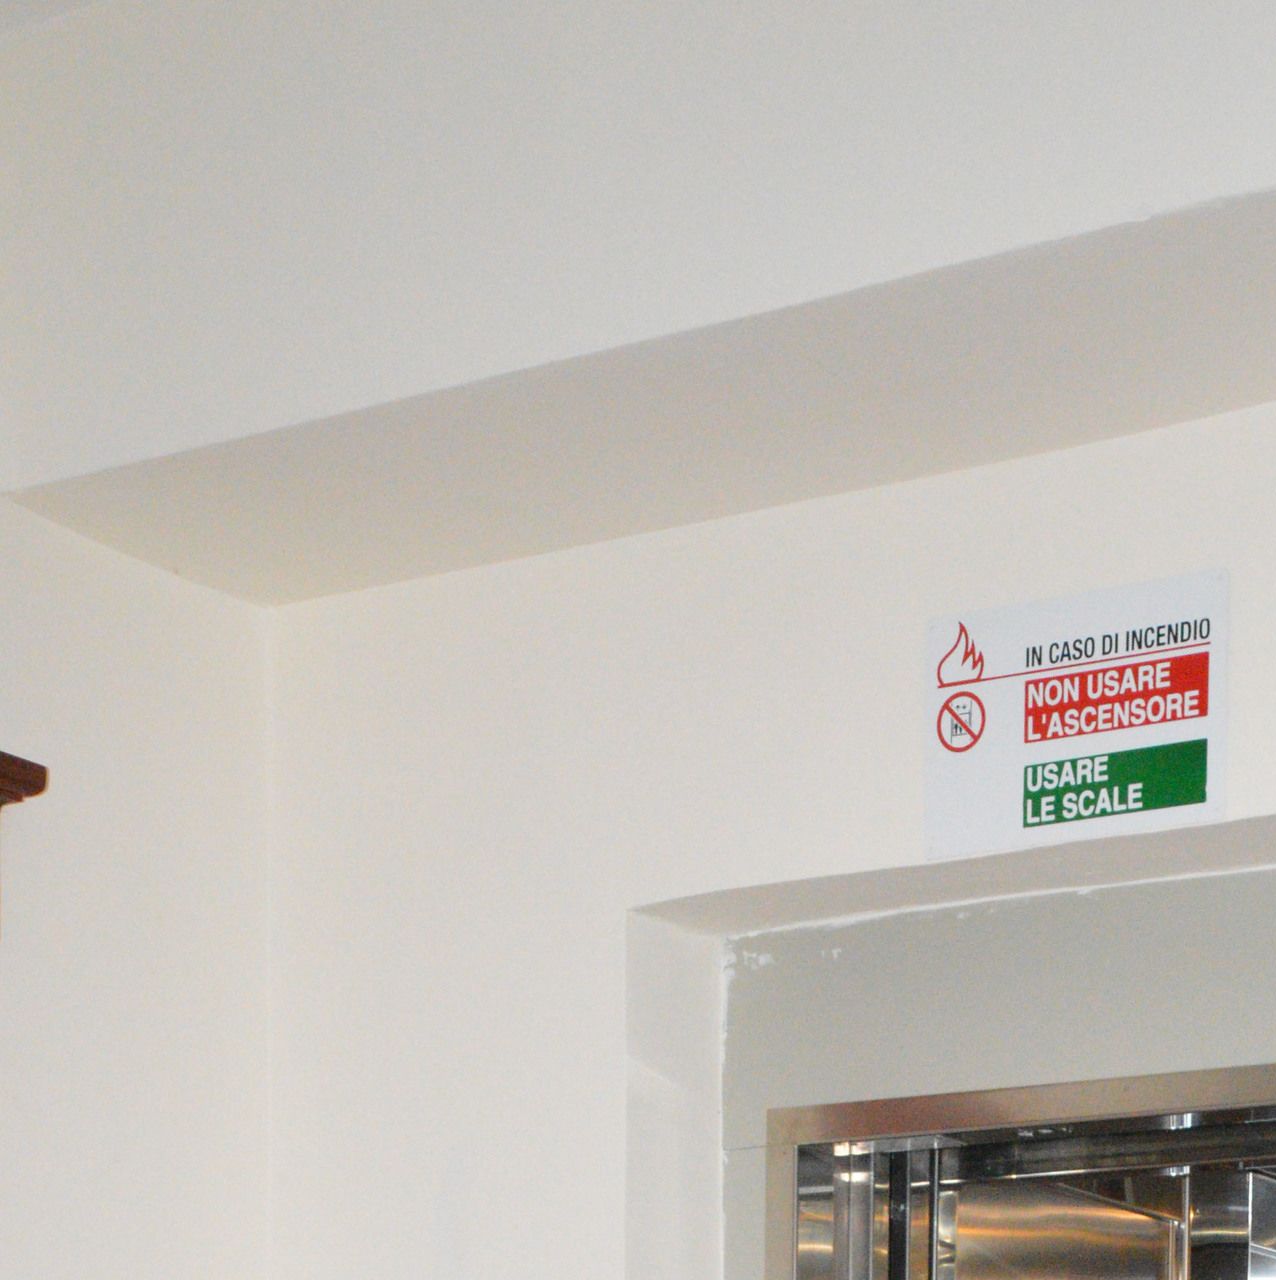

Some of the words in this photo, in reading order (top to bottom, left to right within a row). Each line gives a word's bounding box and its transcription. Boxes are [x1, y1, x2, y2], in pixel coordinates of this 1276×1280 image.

[1025, 645, 1042, 668] IN
[1049, 637, 1095, 664] CASO
[1102, 632, 1119, 655] DI
[1125, 618, 1211, 652] INCENDIO
[1027, 680, 1080, 709] NON
[1086, 662, 1171, 698] USARE
[1027, 690, 1200, 742] L'ASCENSORE
[1027, 756, 1109, 793] USARE
[1027, 796, 1055, 824] LE
[1062, 783, 1143, 818] SCALE
